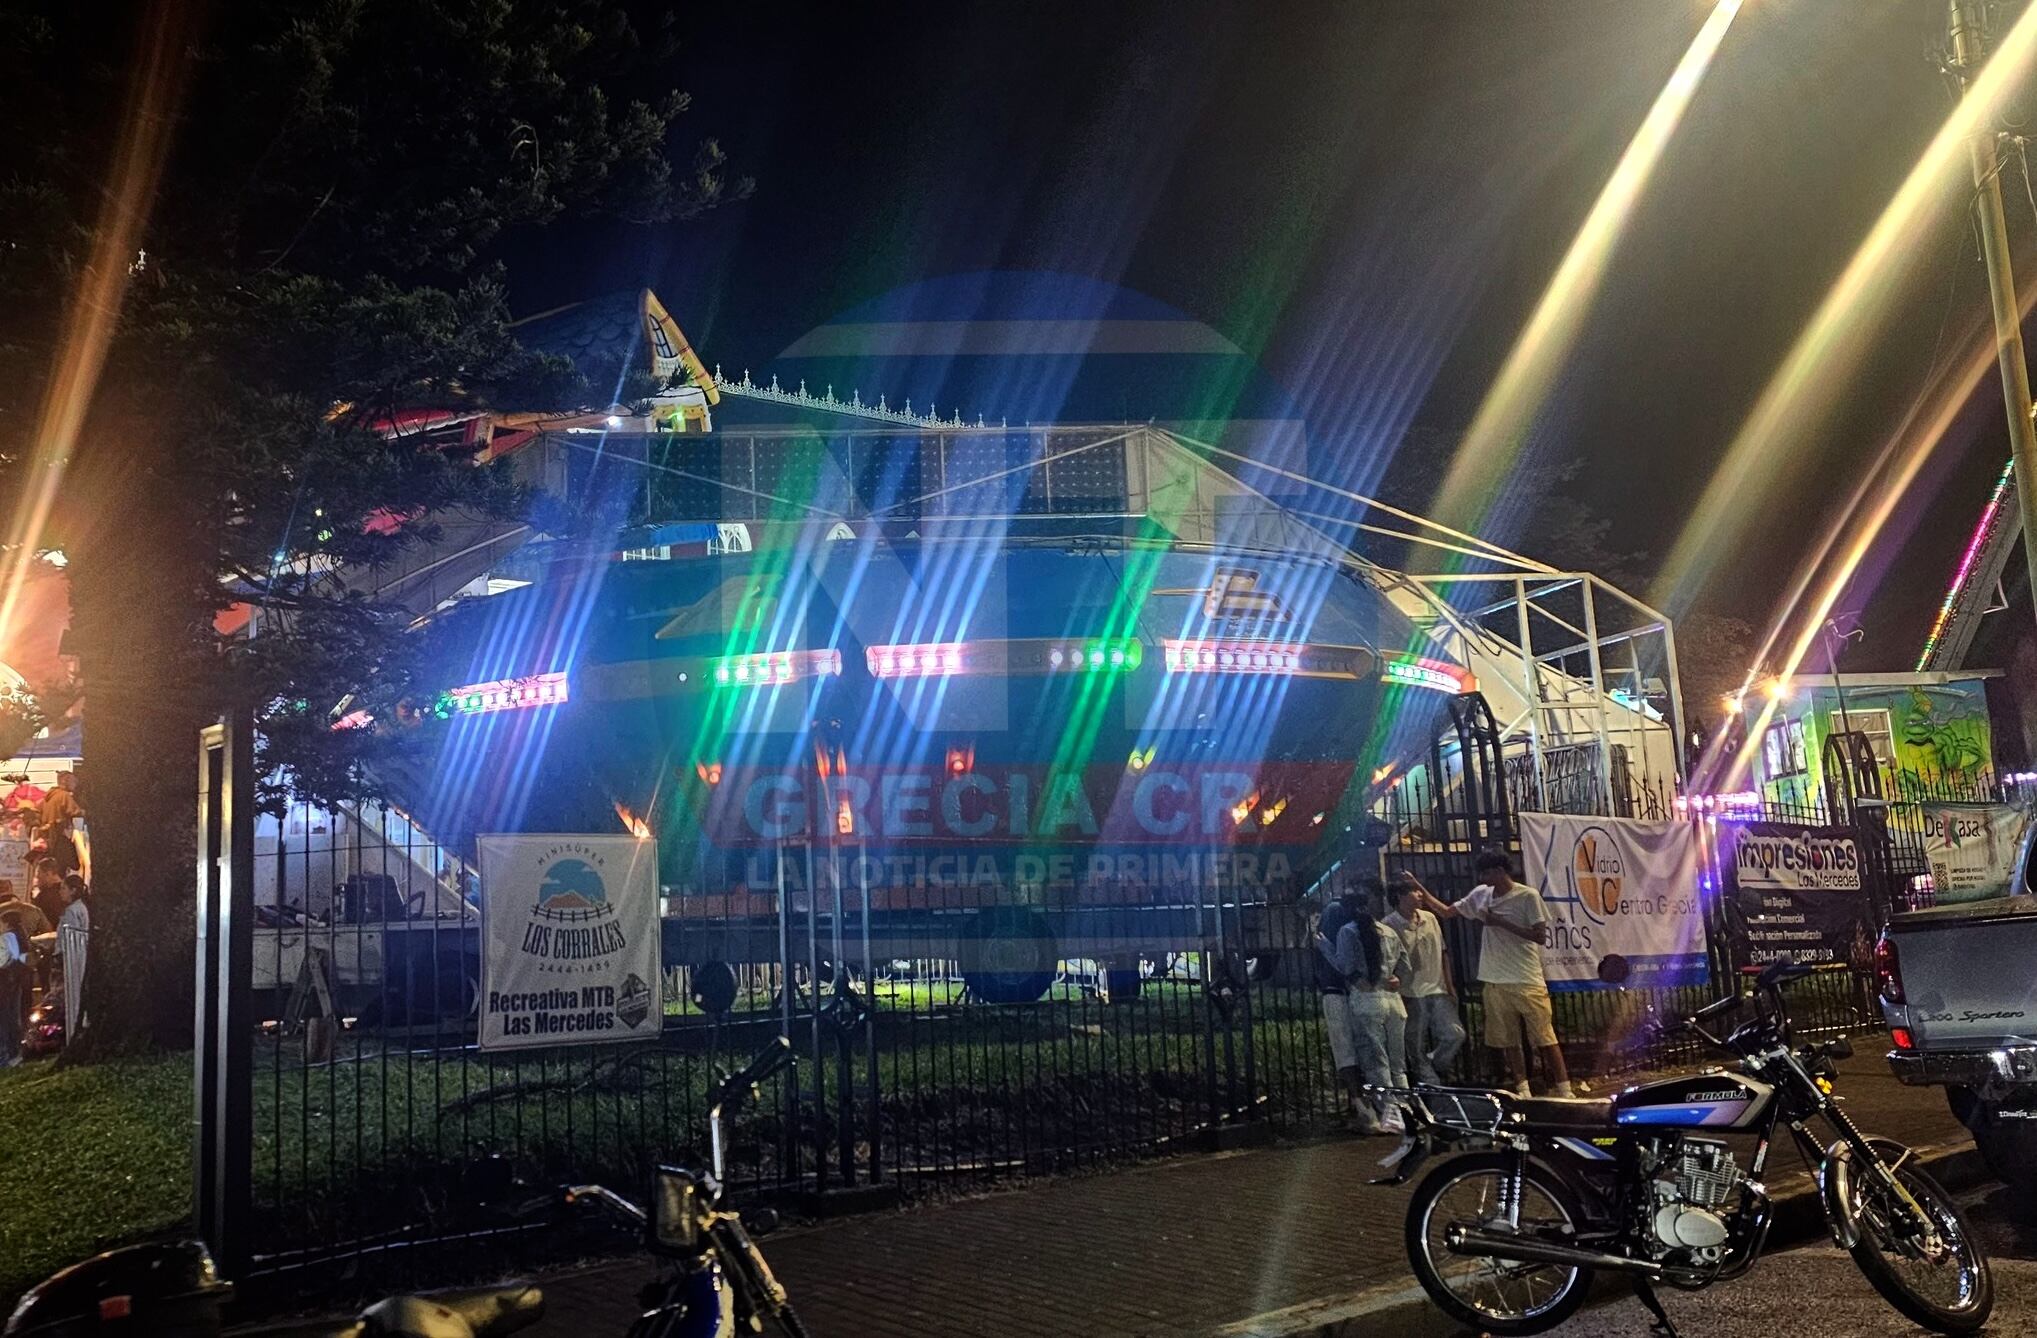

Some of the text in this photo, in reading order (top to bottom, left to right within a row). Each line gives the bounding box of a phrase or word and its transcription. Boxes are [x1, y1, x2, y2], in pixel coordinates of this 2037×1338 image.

[1581, 840, 1620, 874] Vidrio
[1797, 872, 1859, 888] Las Mercedes
[1602, 877, 1697, 916] Centro Gecia
[521, 918, 627, 960] LOS CORRALES
[1747, 930, 1783, 941] Subliación
[489, 988, 578, 1014] Recreativa
[580, 985, 615, 1009] MTB
[503, 1010, 615, 1037] Las Mercedes
[1958, 1010, 2025, 1023] Sportero
[1685, 1089, 1748, 1102] FORMULA
